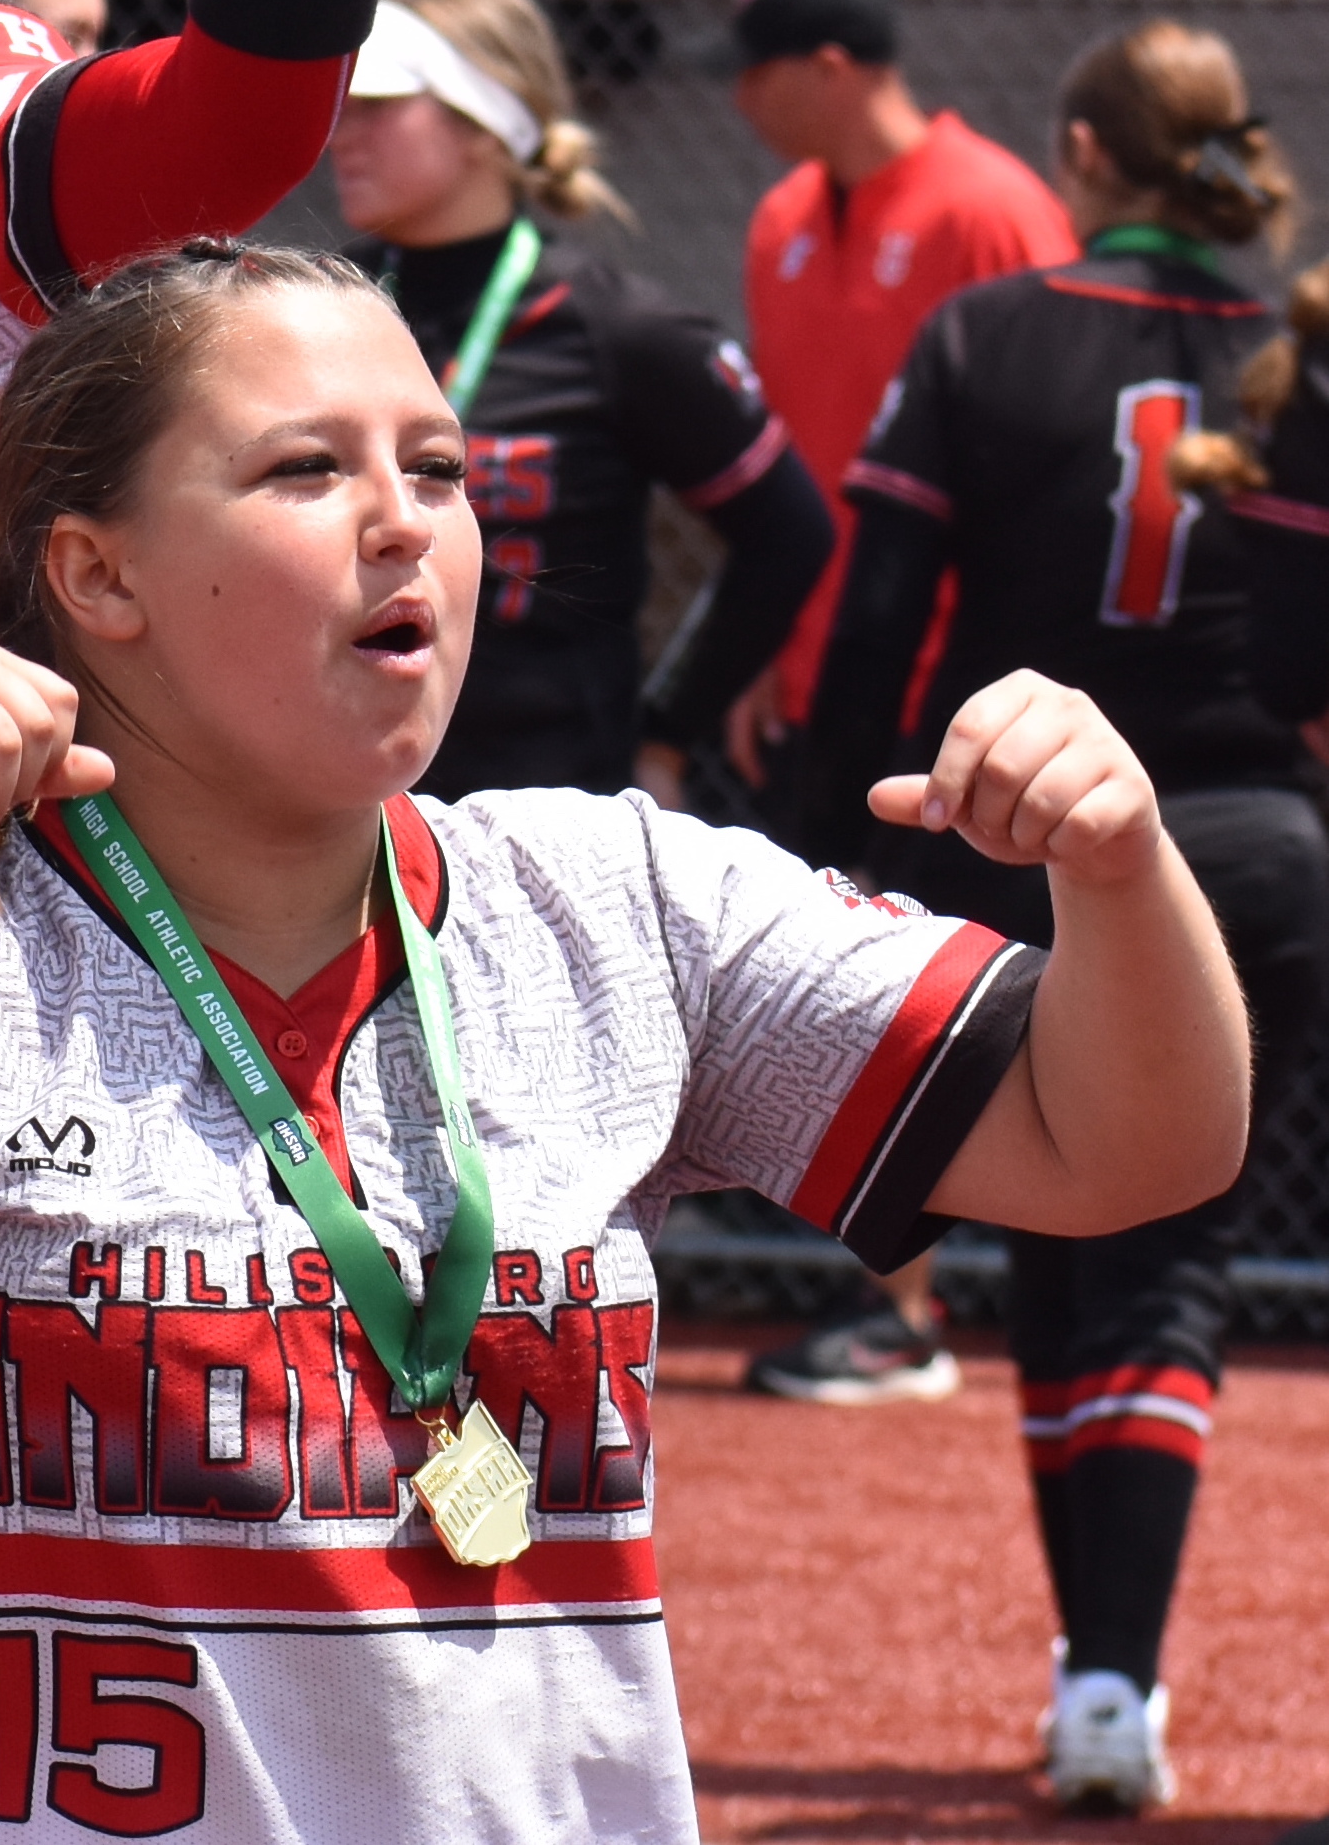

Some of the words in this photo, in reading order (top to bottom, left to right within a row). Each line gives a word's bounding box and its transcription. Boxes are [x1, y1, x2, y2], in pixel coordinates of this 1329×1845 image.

[78, 797, 109, 840] HIGH
[103, 841, 150, 903] SCHOOL
[145, 909, 204, 984] ATHLETIC
[196, 992, 269, 1097] ASSOCIATION
[272, 1119, 306, 1165] OHSAA
